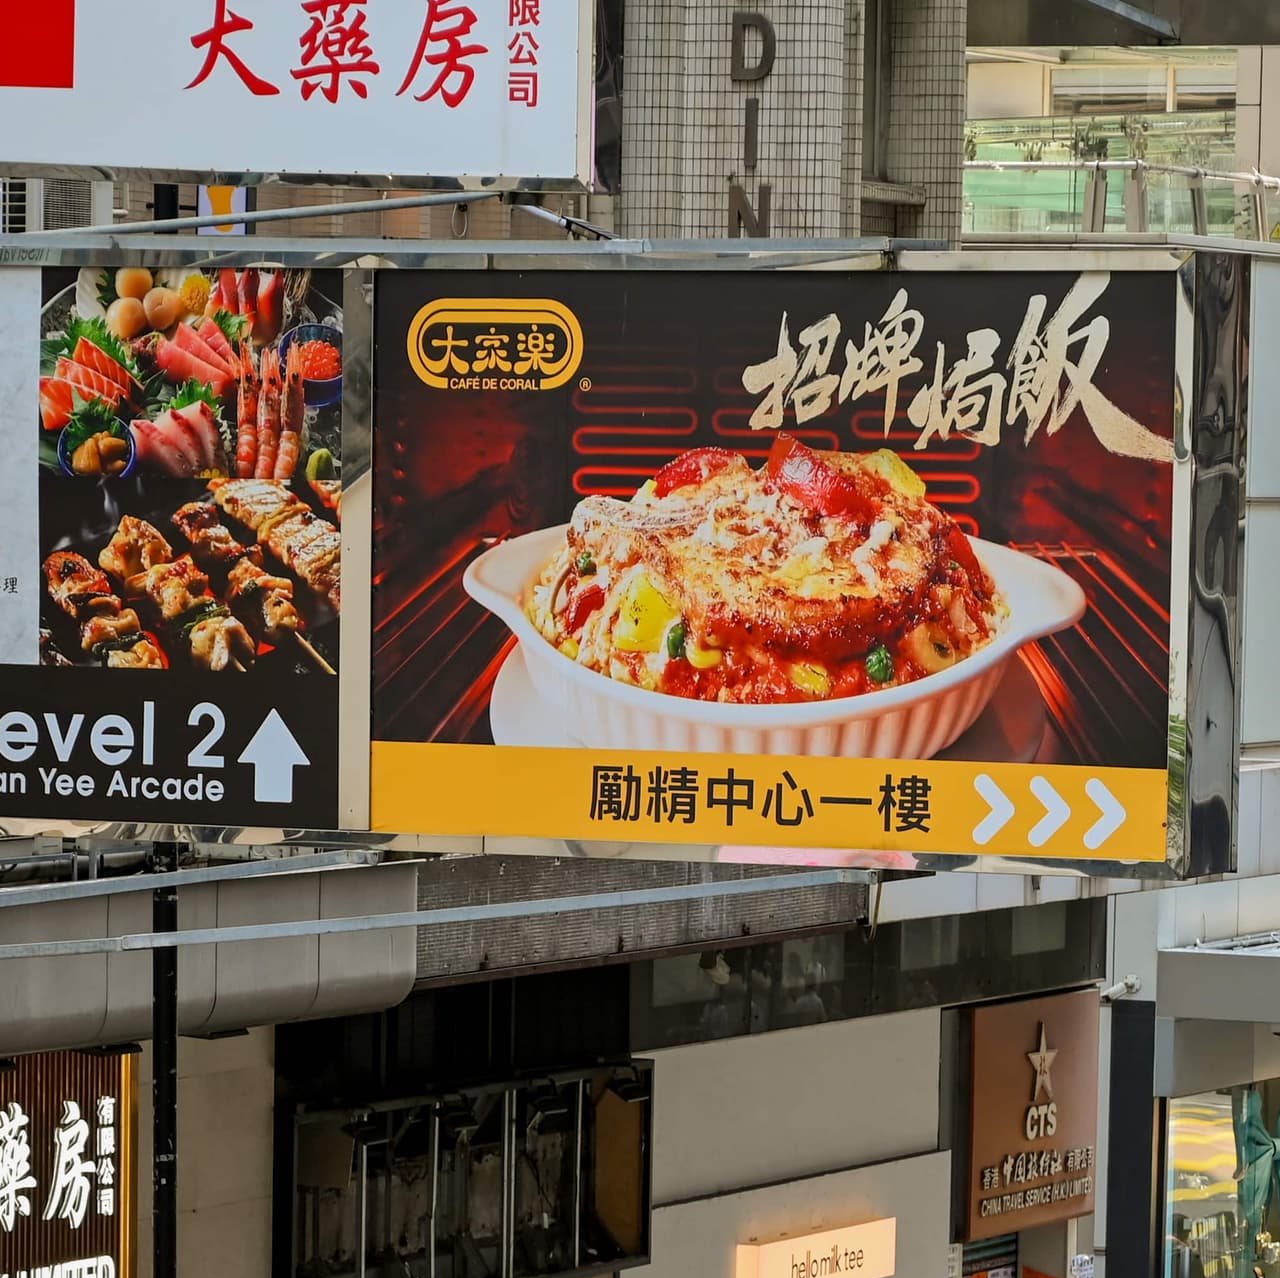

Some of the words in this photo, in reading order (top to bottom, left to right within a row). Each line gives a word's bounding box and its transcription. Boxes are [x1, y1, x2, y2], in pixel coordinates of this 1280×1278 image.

[184, 0, 489, 108] 大藥房
[450, 376, 480, 390] CAFÉ
[482, 378, 497, 390] DE
[499, 378, 539, 390] CORAL
[743, 272, 1174, 462] 招牌焗飯
[187, 702, 225, 768] 2
[38, 768, 95, 797] Yee
[106, 770, 225, 802] Arcade
[590, 764, 933, 834] 勵精中心一樓
[1026, 1102, 1057, 1140] CTS
[97, 1096, 115, 1216] 有限公司
[981, 1197, 1002, 1217] CHINA
[1003, 1191, 1024, 1212] TRAVEL
[1025, 1186, 1051, 1207] SERVICE
[1070, 1176, 1092, 1197] LIMITED
[845, 1249, 864, 1271] tee
